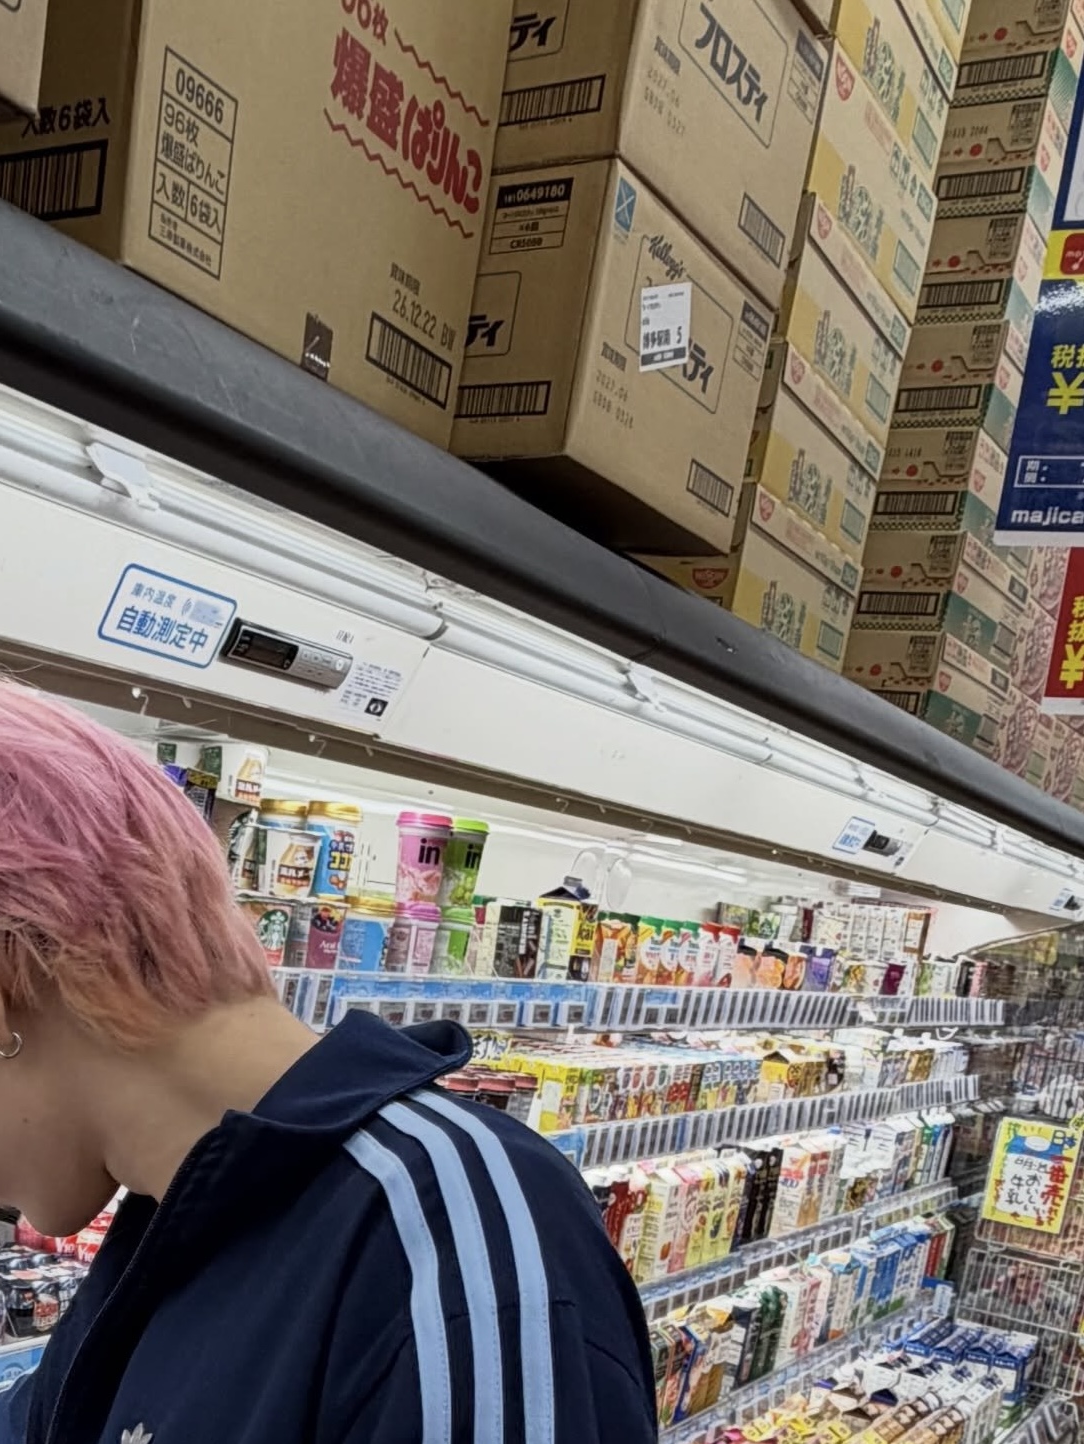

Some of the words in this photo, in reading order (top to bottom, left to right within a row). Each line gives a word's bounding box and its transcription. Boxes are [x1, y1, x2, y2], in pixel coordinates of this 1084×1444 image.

[695, 2, 767, 124] フロスティ
[175, 67, 224, 125] 09666
[331, 27, 482, 214] 爆盛ぱりんこ
[164, 103, 199, 148] 96枚
[156, 172, 185, 210] 入数
[190, 194, 221, 234] 6袋入
[116, 605, 209, 653] 自動測定中
[418, 837, 441, 865] in
